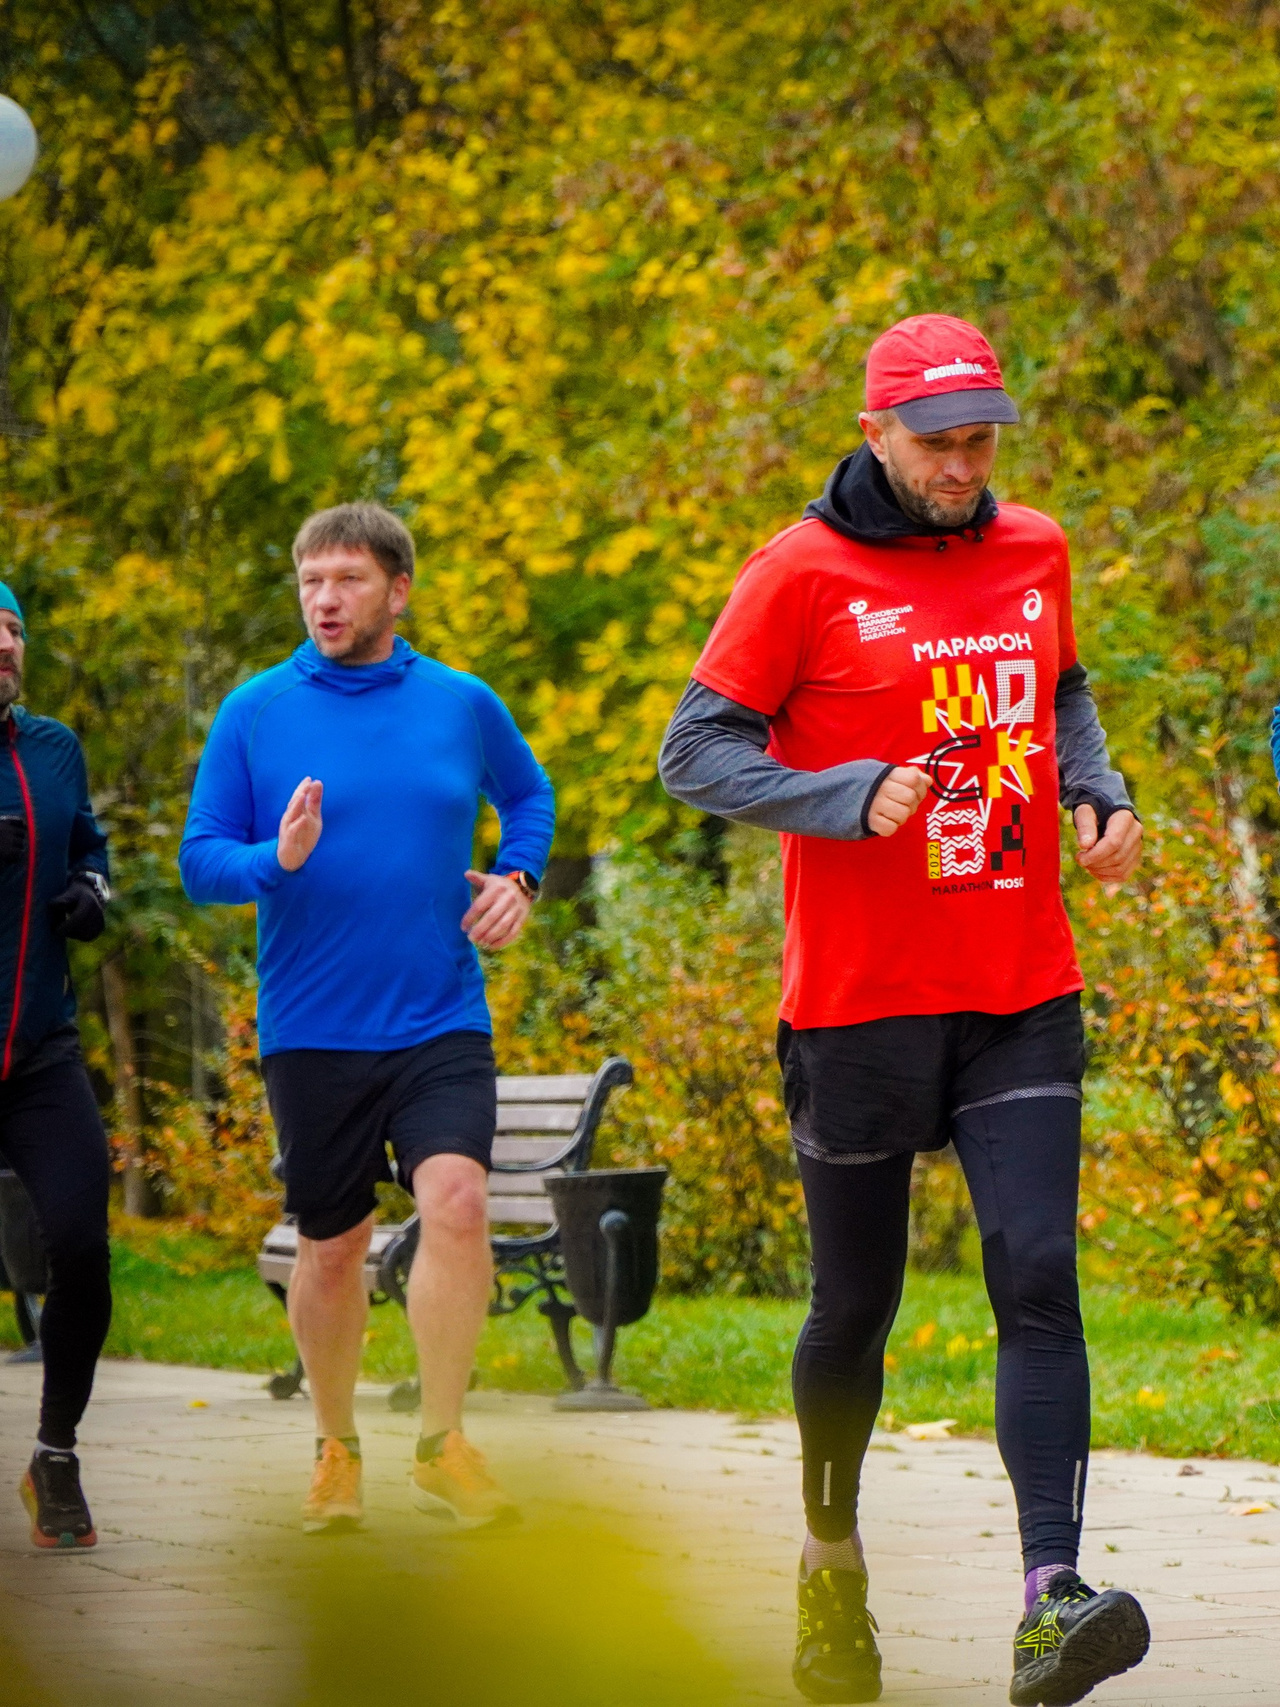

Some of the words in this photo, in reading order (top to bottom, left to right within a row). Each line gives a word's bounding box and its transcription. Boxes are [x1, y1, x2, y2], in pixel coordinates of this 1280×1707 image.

[856, 604, 913, 622] МОСКОВСКИЙ
[858, 615, 899, 629] МАРАФОН
[859, 622, 896, 636] MOSCOW
[860, 627, 906, 643] MARATHON
[912, 633, 1033, 662] МАРАФОН
[929, 842, 940, 878] 2022
